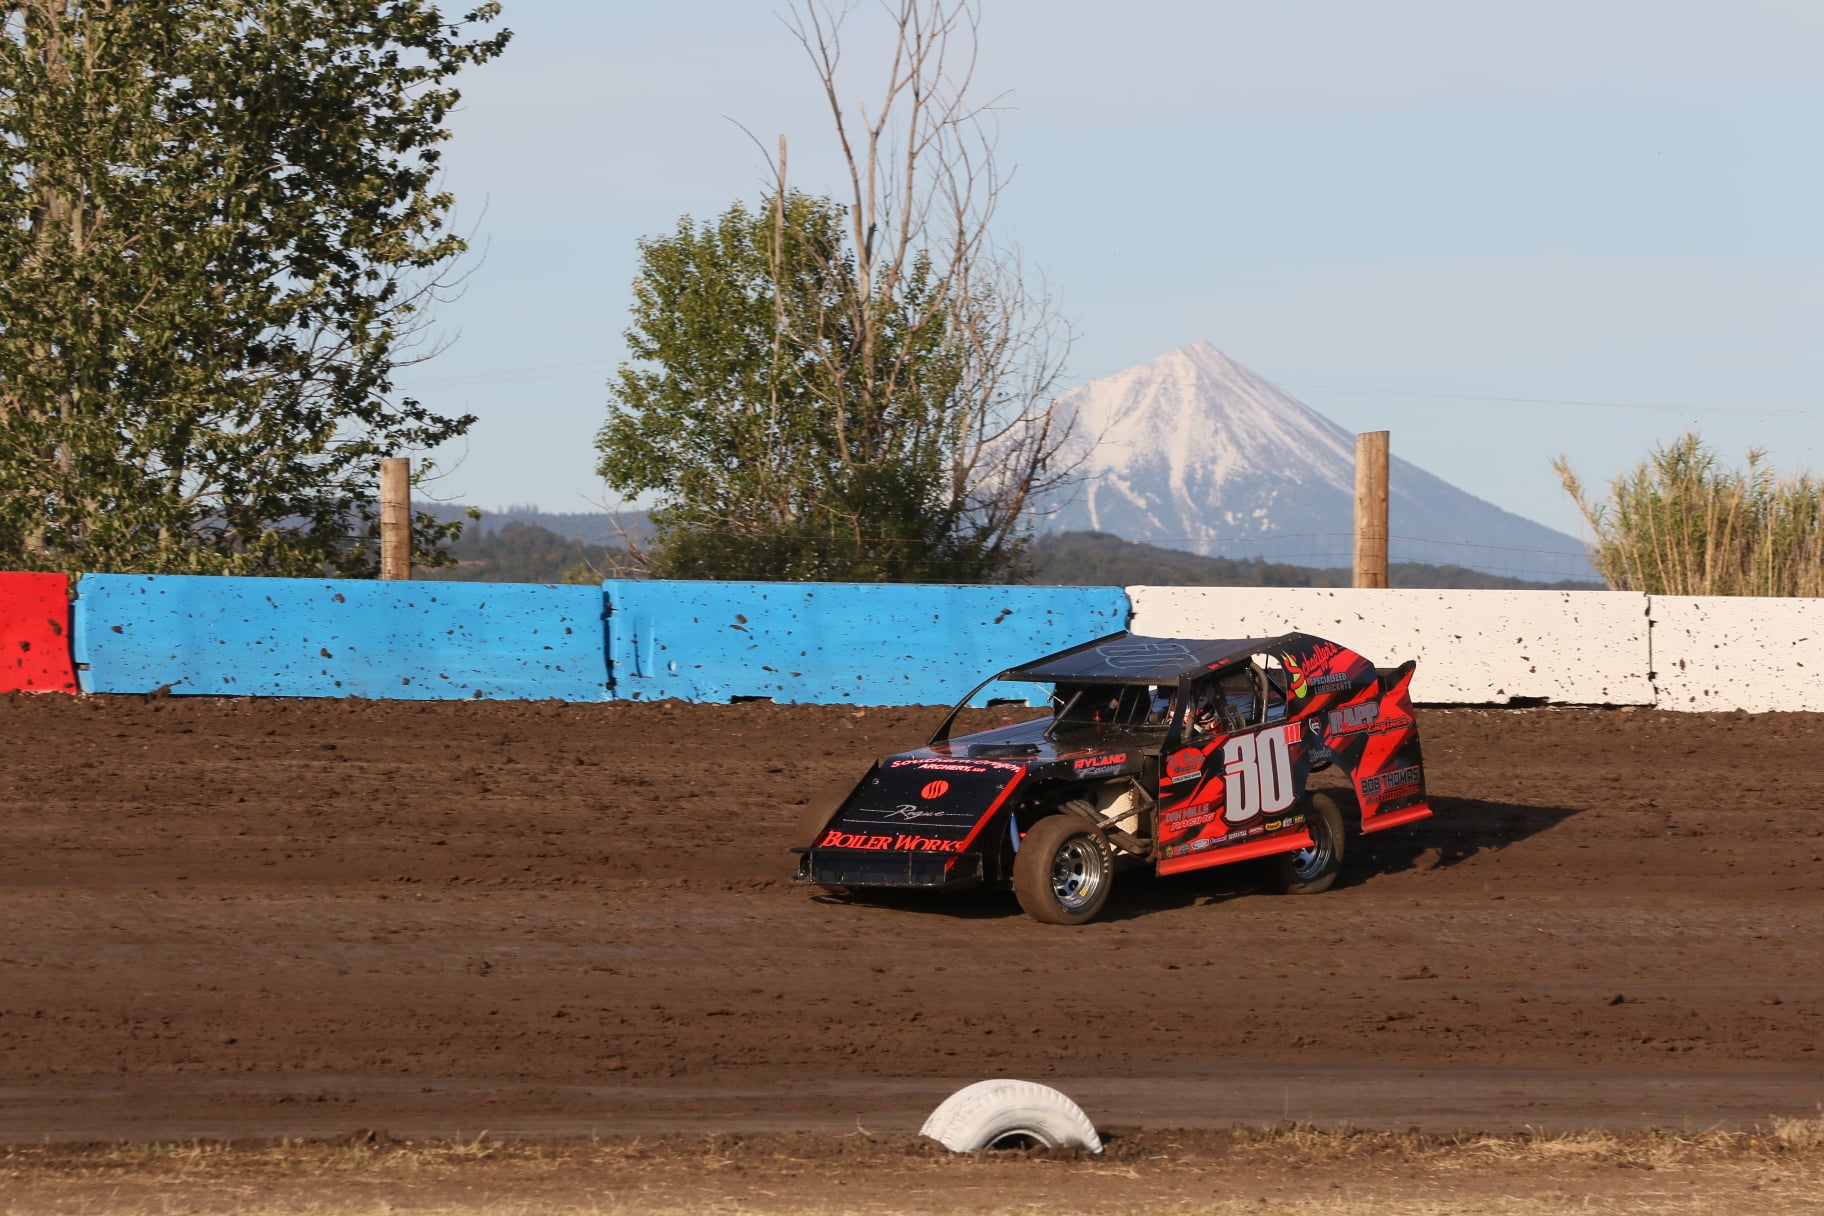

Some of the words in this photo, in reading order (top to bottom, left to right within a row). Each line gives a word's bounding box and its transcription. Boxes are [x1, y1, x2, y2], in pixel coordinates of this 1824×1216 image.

[1309, 672, 1347, 687] SPECIALIZED
[1313, 681, 1352, 695] LUBRICANTS
[1329, 702, 1379, 734] RAPP
[1074, 753, 1126, 769] RYLAND
[1222, 725, 1296, 823] 30
[1361, 776, 1380, 795] BOB
[1382, 767, 1420, 789] THOMAS
[884, 804, 944, 820] Rogue
[1170, 812, 1216, 832] RACING
[821, 830, 892, 850] BOILER
